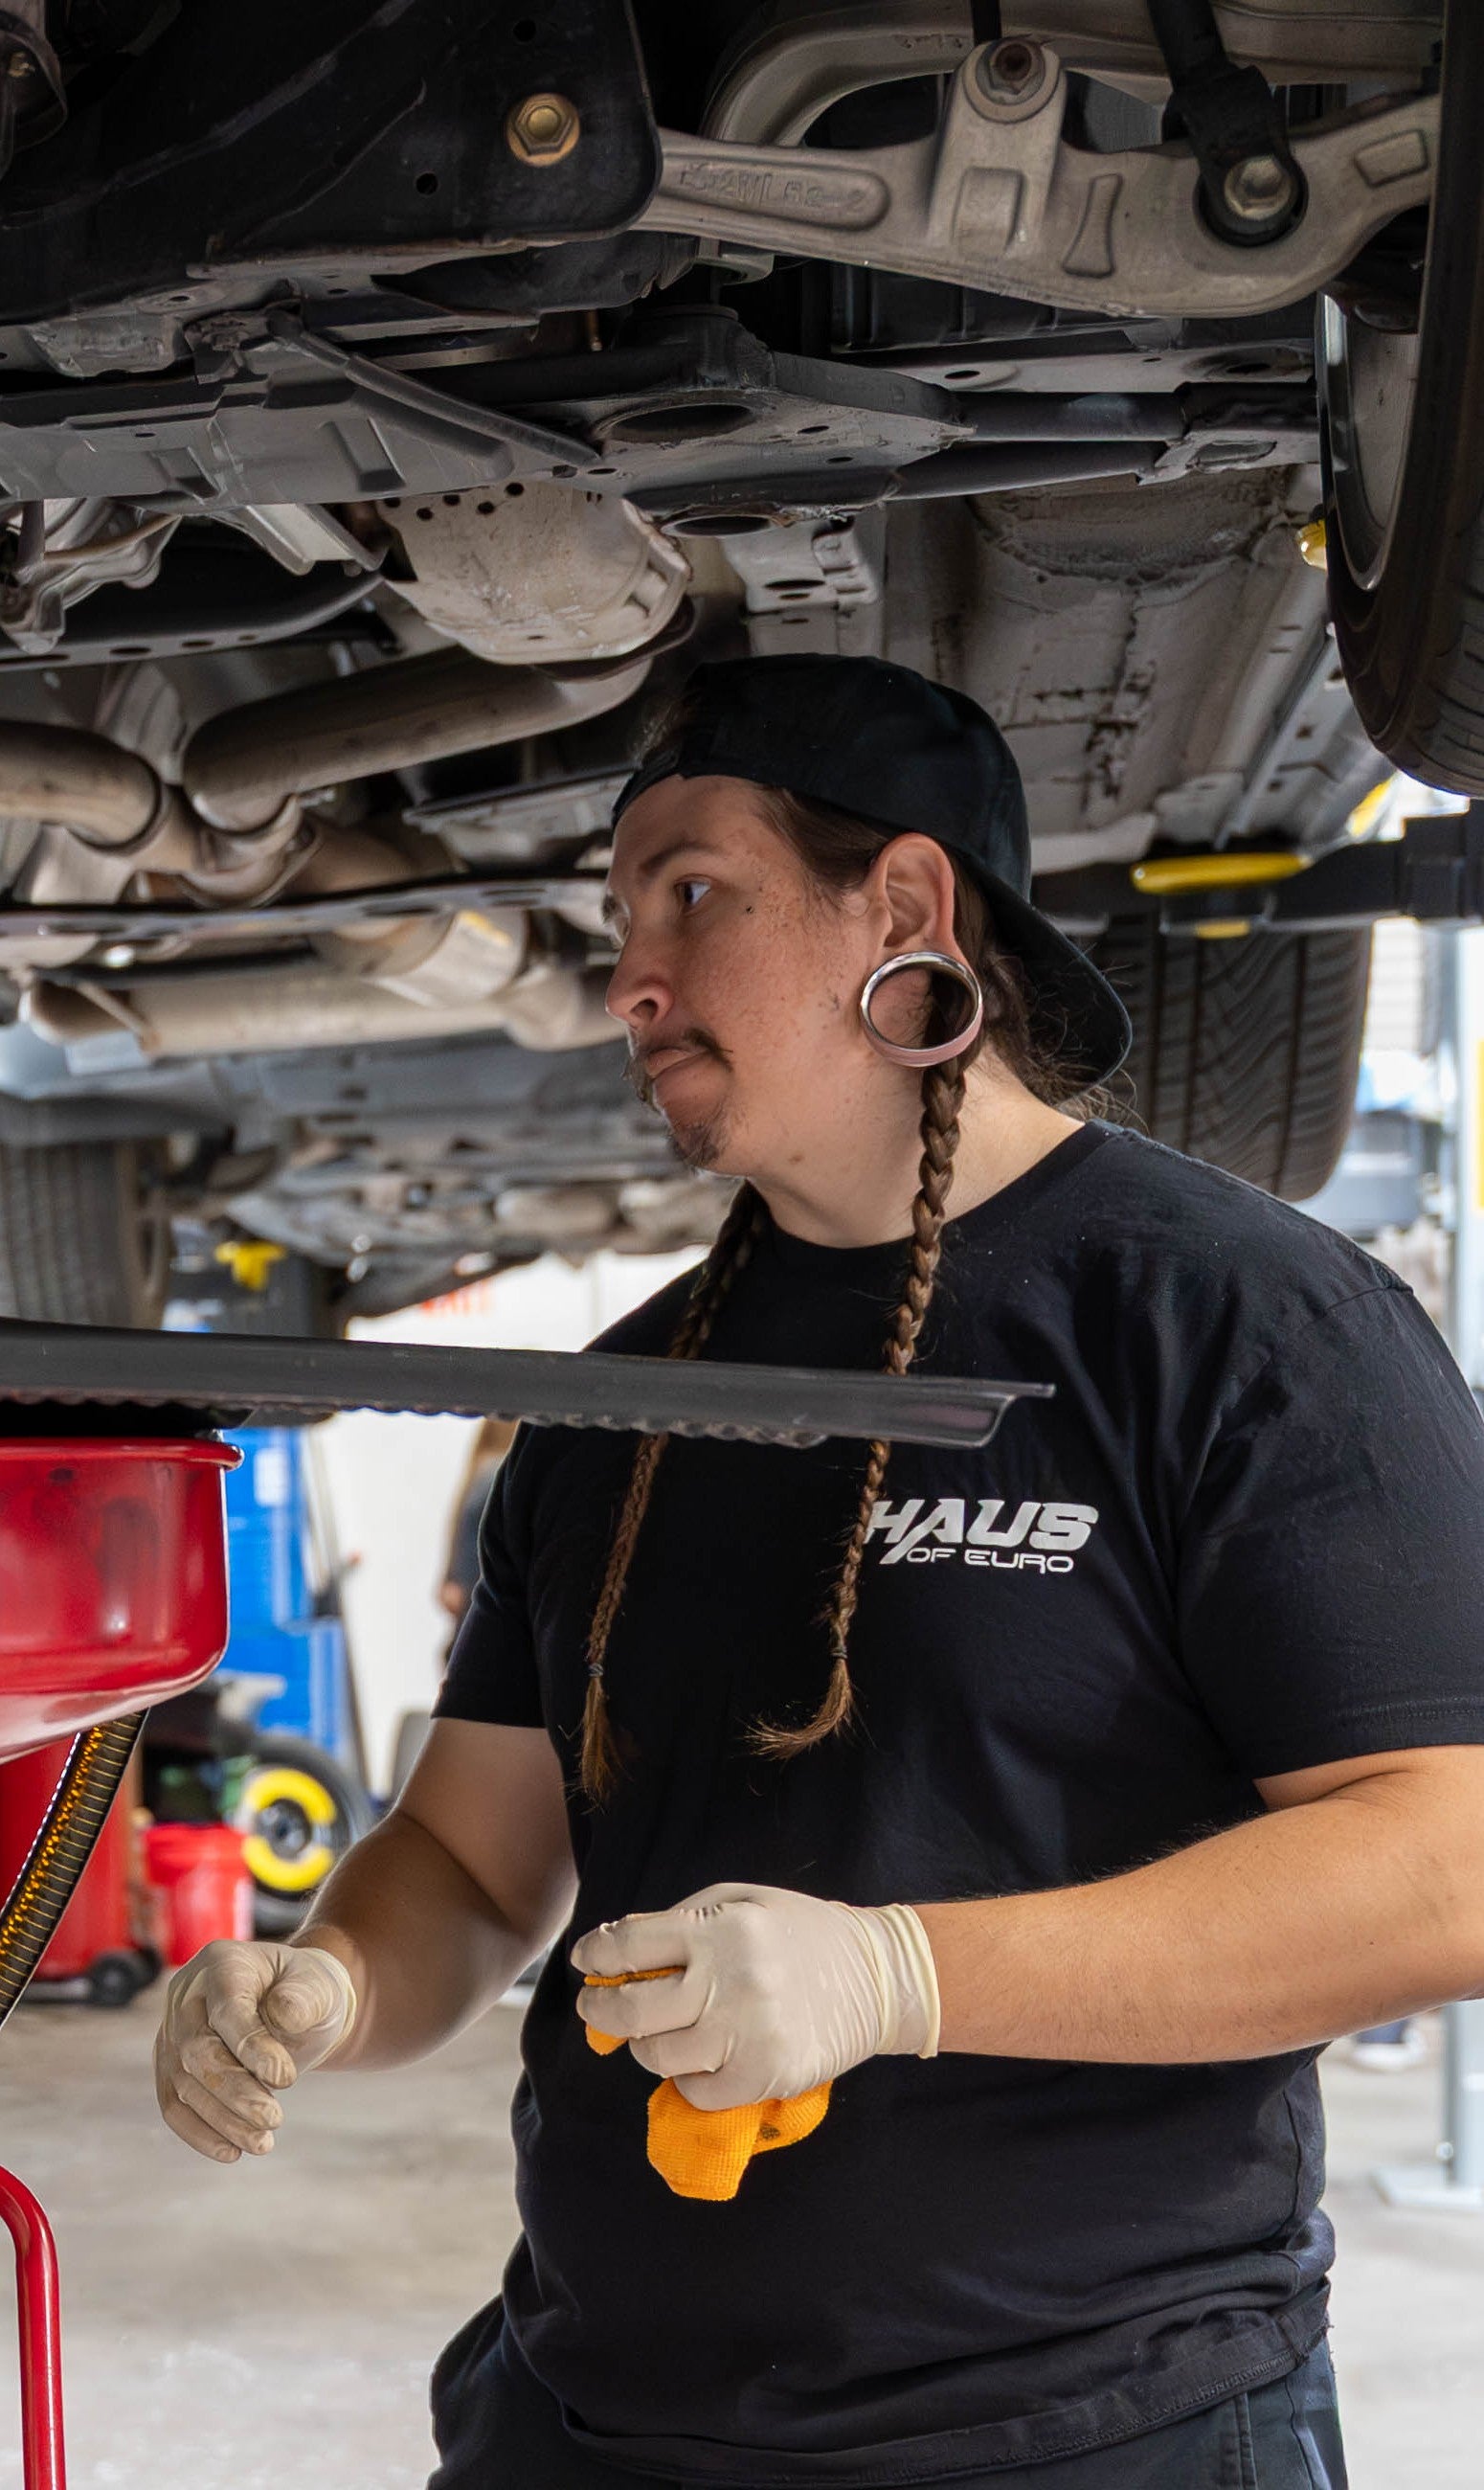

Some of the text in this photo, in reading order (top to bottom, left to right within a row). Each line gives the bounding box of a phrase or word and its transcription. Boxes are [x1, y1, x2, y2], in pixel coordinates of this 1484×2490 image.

[864, 1498, 1099, 1564] HAUS
[906, 1547, 1074, 1573] OF EURO
